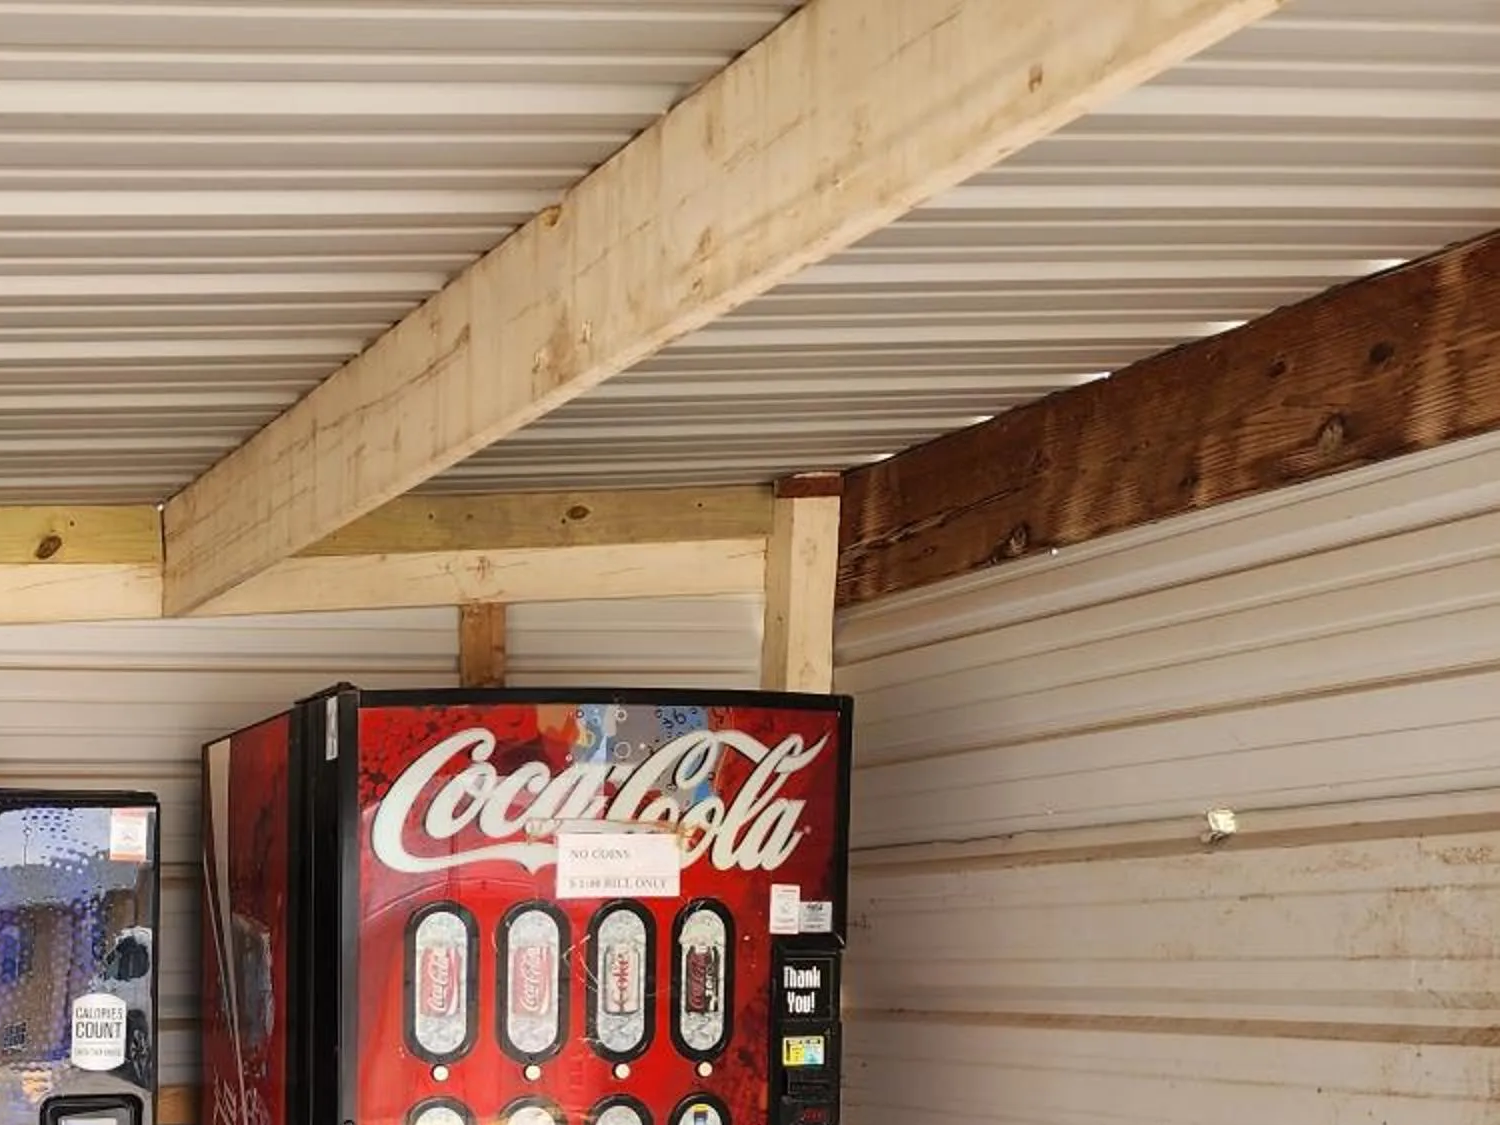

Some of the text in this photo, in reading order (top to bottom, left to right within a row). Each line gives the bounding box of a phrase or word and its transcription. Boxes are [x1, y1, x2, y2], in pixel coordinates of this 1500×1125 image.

[569, 849, 630, 859] NO COINS
[635, 879, 667, 889] ONLY
[783, 965, 821, 989] Thank
[786, 991, 816, 1014] You!
[75, 1007, 123, 1020] CALORIES
[75, 1022, 123, 1039] COUNT
